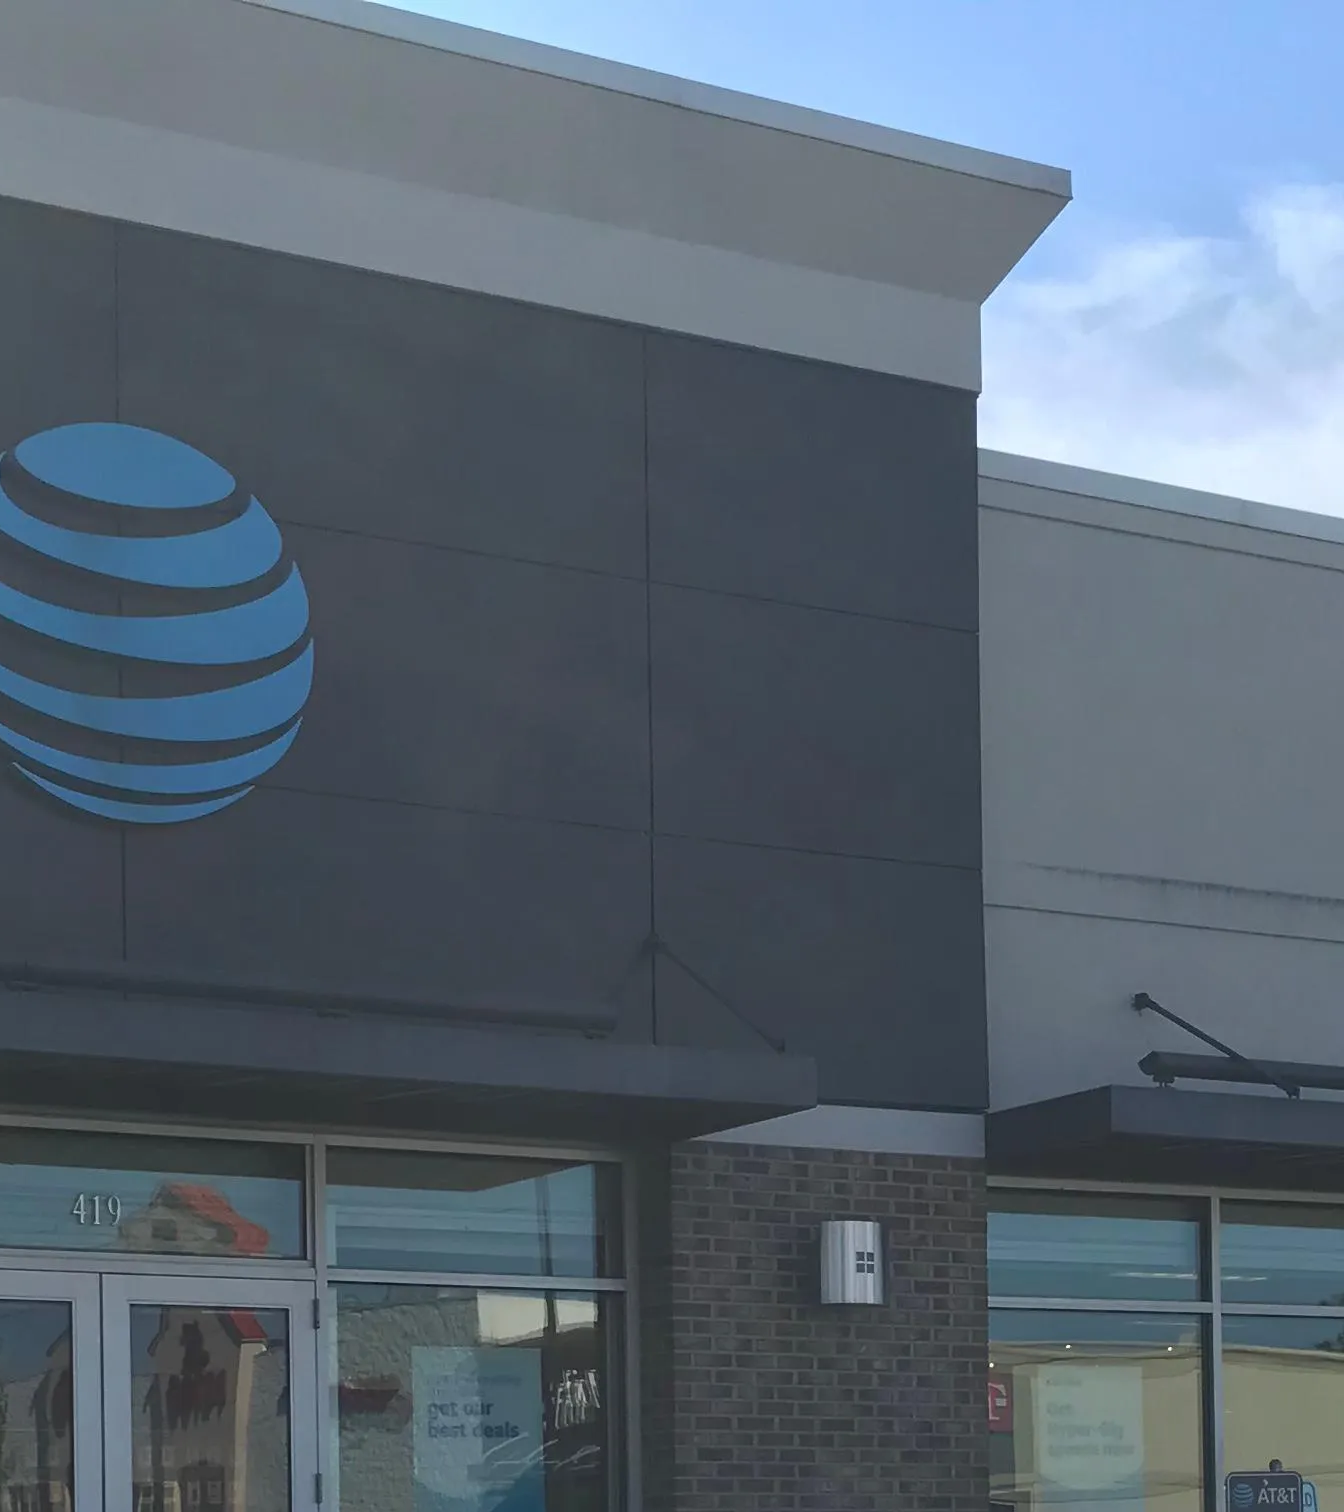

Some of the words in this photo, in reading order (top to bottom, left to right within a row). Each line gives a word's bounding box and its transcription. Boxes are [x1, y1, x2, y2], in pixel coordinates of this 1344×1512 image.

[72, 1193, 121, 1226] 419
[472, 1420, 521, 1438] deals
[1257, 1487, 1298, 1504] AT&T
